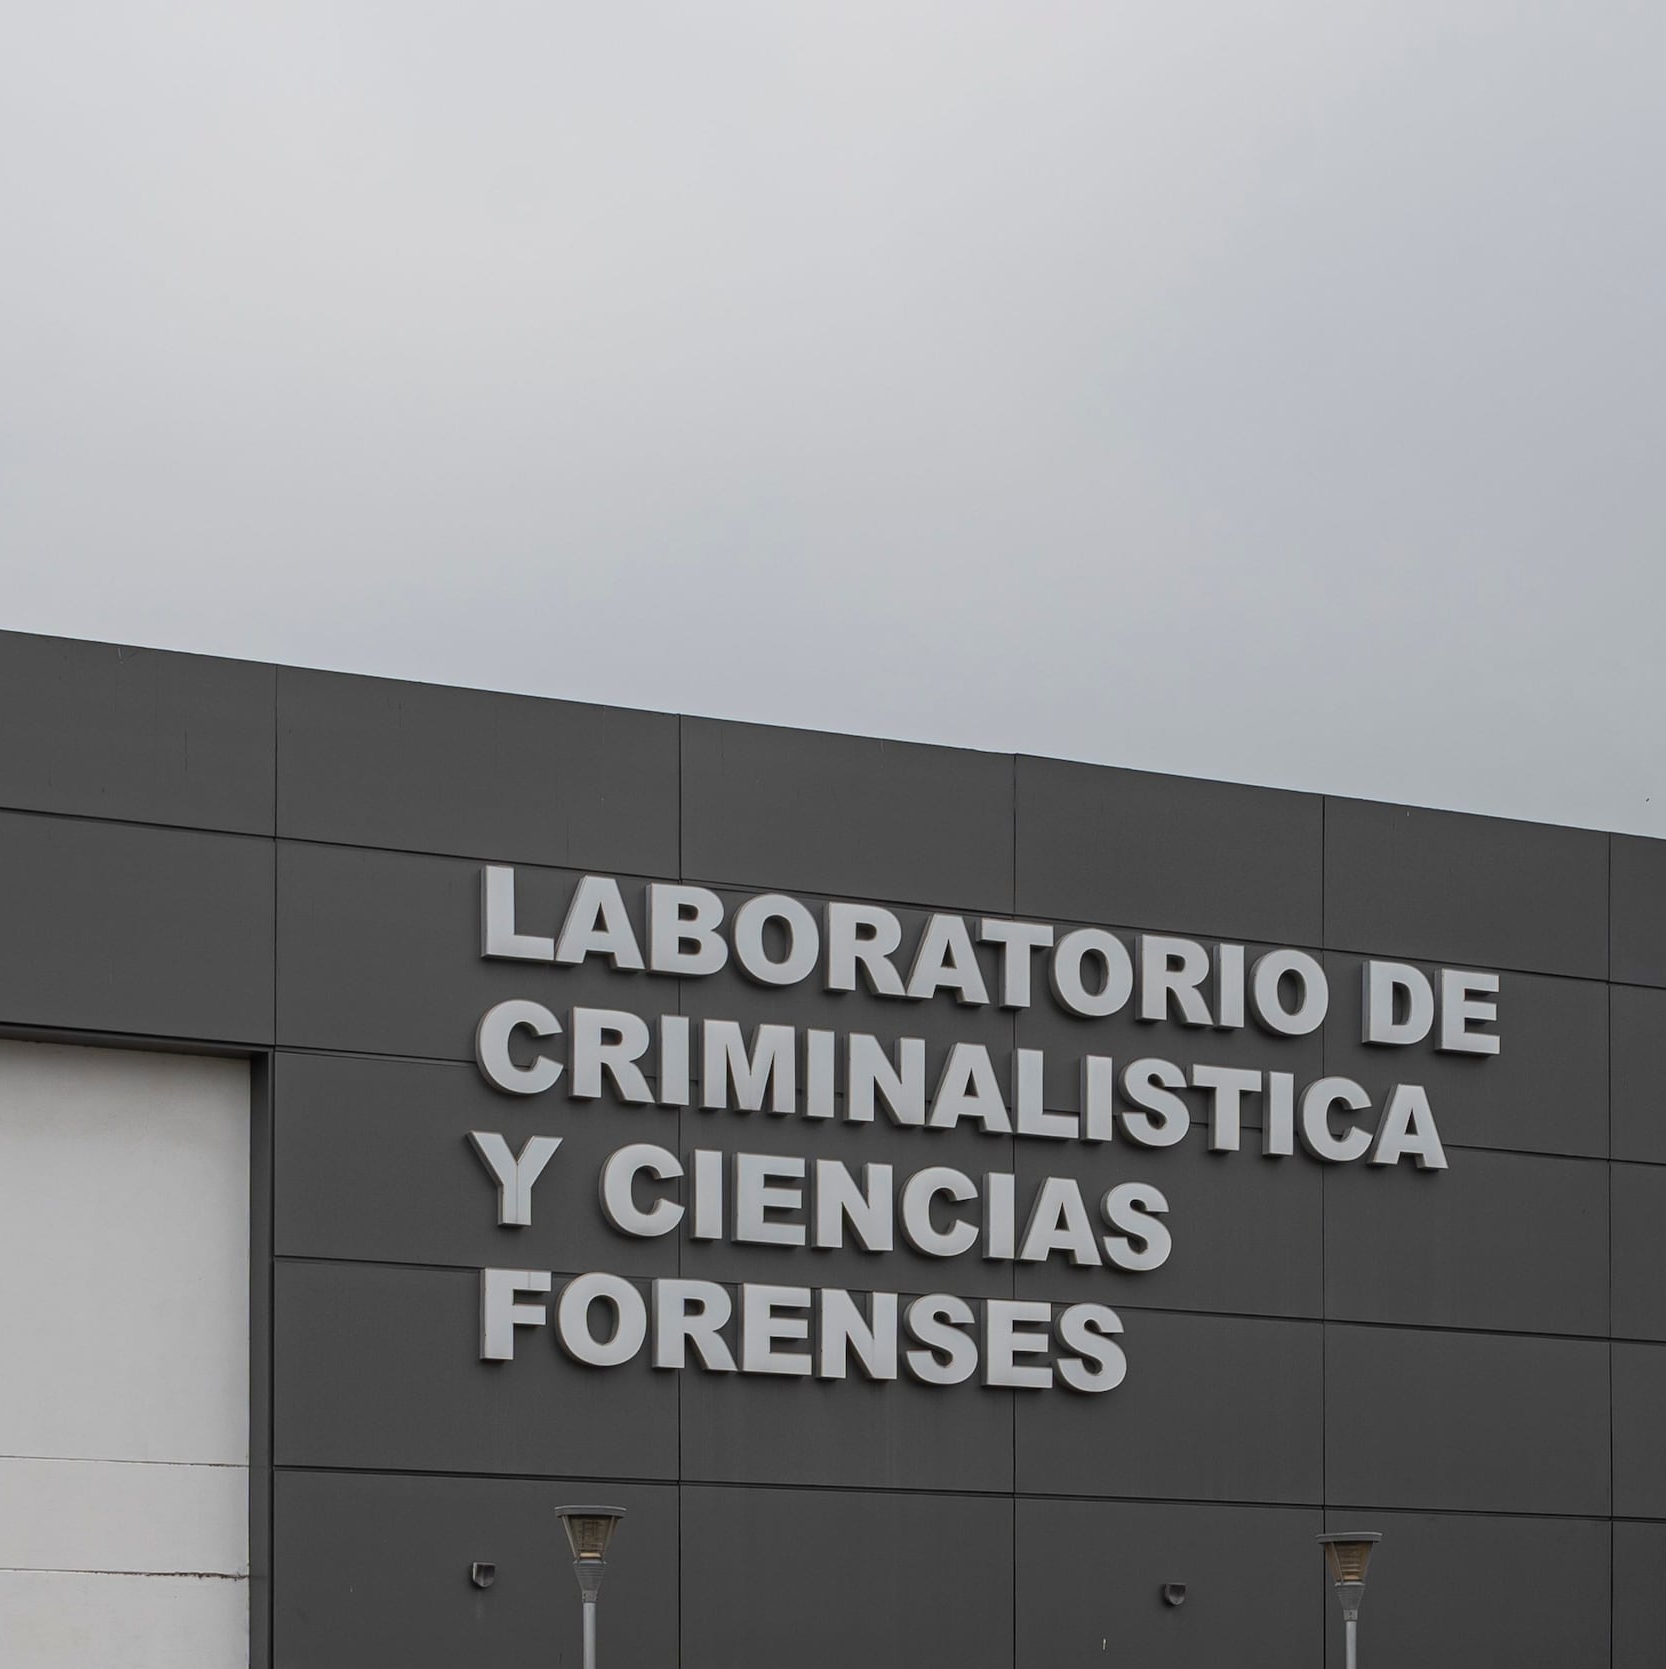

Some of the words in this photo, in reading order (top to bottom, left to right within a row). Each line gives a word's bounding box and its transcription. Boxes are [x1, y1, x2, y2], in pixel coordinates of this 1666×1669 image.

[481, 864, 1330, 1036] LABORATORIO
[1362, 958, 1502, 1056] DE
[474, 997, 1451, 1171] CRIMINALISTICA
[470, 1128, 564, 1227] Y
[603, 1141, 1174, 1272] CIENCIAS
[482, 1265, 1129, 1394] FORENSES
